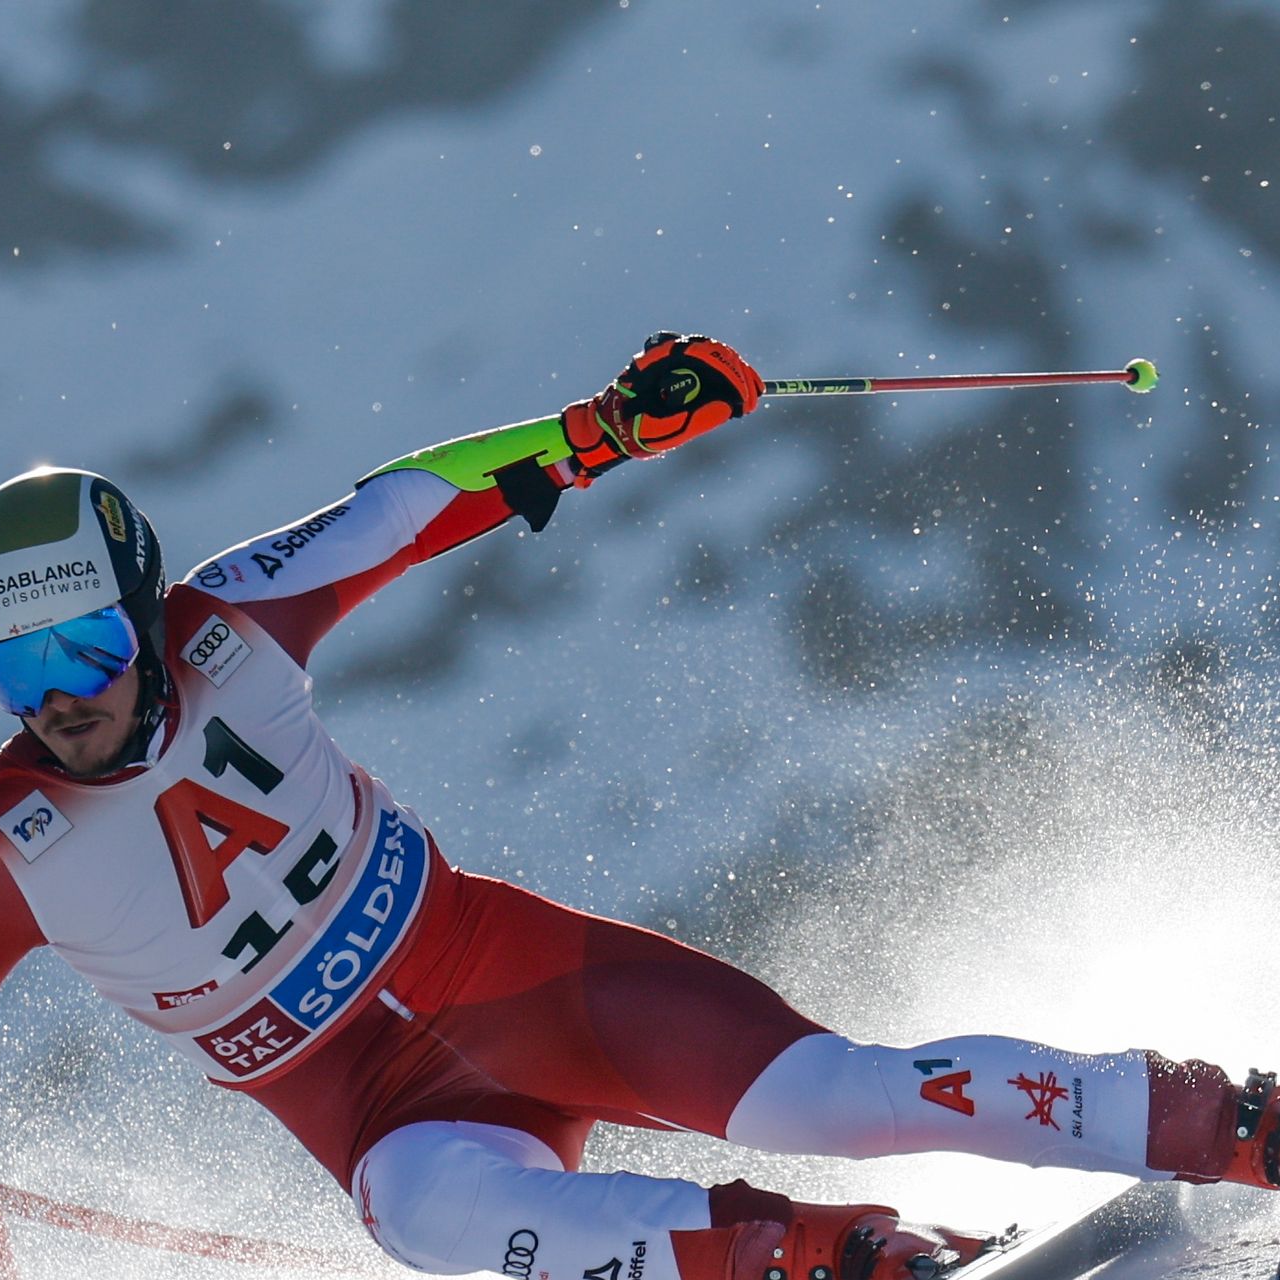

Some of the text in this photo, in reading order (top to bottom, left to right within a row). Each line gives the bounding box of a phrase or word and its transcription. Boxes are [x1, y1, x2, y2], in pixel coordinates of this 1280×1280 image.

[776, 381, 812, 393] LEKI
[612, 396, 629, 442] LEKI
[126, 501, 146, 575] ATOM
[154, 716, 290, 929] A1
[298, 811, 405, 1019] SÖLDEN
[210, 1016, 277, 1056] ÖTZ
[228, 1035, 293, 1068] TAL
[913, 1059, 975, 1117] A1
[1072, 1077, 1083, 1139] Ski Austria
